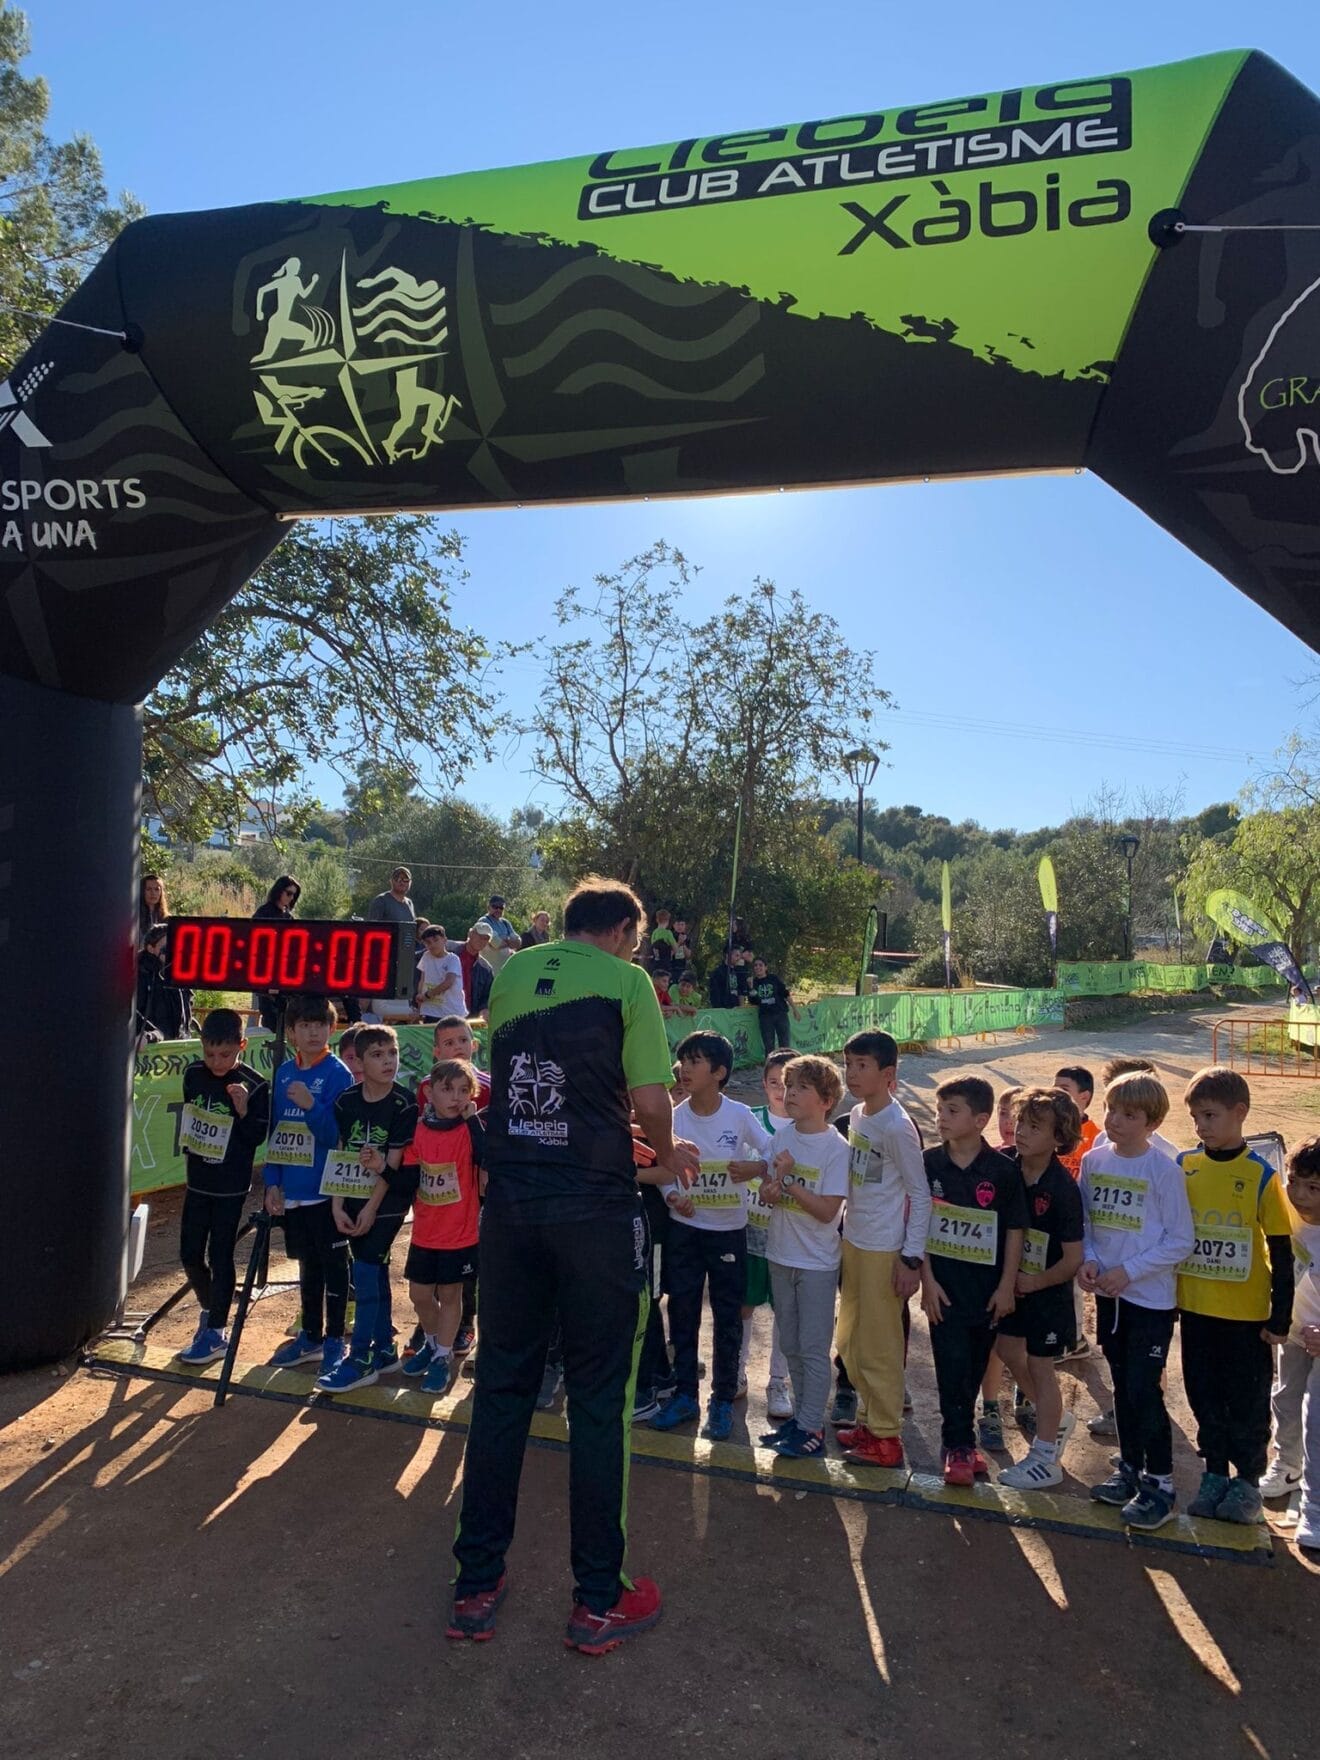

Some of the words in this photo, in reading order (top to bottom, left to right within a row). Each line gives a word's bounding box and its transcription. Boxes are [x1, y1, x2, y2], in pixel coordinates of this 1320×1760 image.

[588, 169, 739, 215] CLUB
[757, 118, 1120, 192] ATLETISME
[837, 173, 1132, 257] Xàbia
[1259, 376, 1320, 410] GR
[1, 478, 147, 511] SPORTS
[31, 519, 98, 551] UNA
[171, 924, 392, 991] 00:00:00
[191, 1118, 219, 1138] 2030
[508, 1118, 568, 1134] Llebeig
[275, 1132, 304, 1147] 2070
[334, 1162, 371, 1179] 2114
[1092, 1186, 1133, 1207] 2113
[939, 1217, 983, 1240] 2174
[1193, 1239, 1236, 1258] 2073
[1206, 1257, 1221, 1265] DANI
